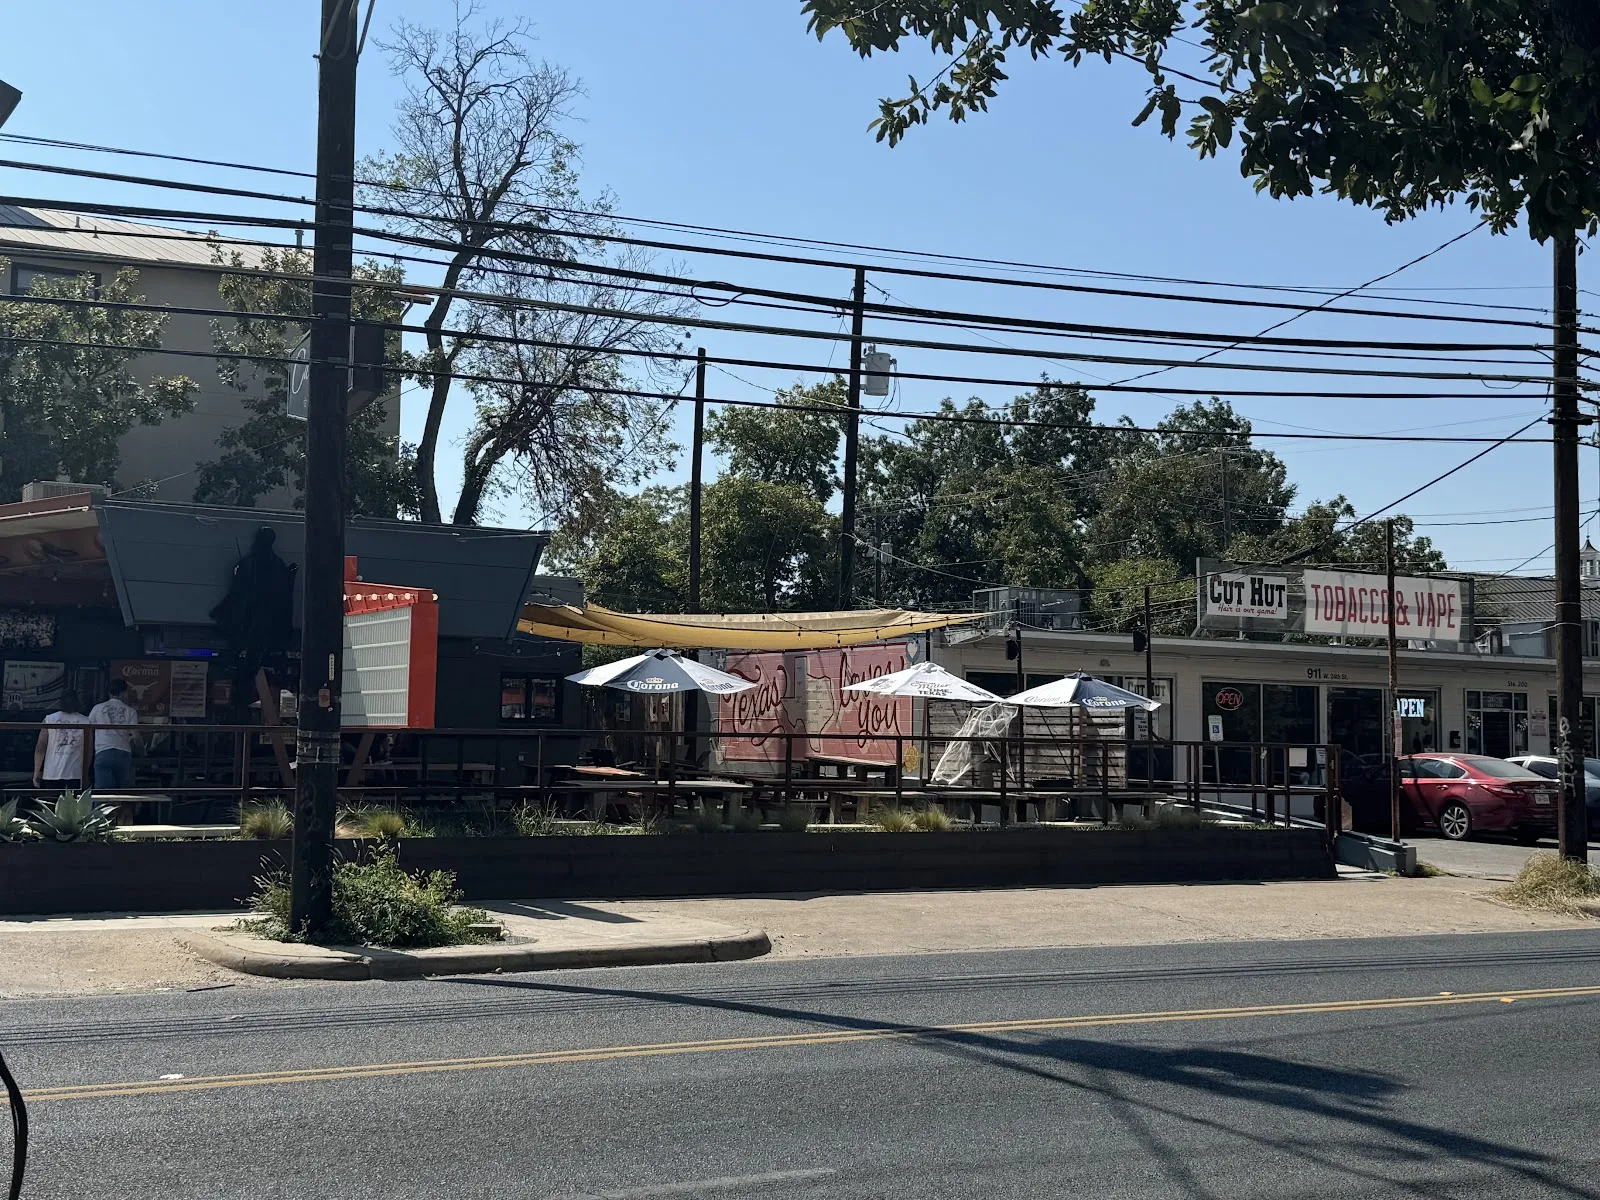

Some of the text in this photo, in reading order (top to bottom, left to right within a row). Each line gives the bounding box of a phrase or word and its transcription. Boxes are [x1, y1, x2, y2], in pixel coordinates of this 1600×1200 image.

[1210, 574, 1286, 607] CUT HUT
[1218, 603, 1233, 612] Hair
[1257, 607, 1278, 616] game!
[1311, 584, 1456, 628] TOBACCO & VAPE
[1307, 667, 1321, 679] 911
[626, 679, 679, 691] Corona
[722, 665, 788, 736] Texas
[1081, 698, 1127, 708] Corona
[1217, 691, 1241, 705] OPEN
[857, 700, 903, 748] you
